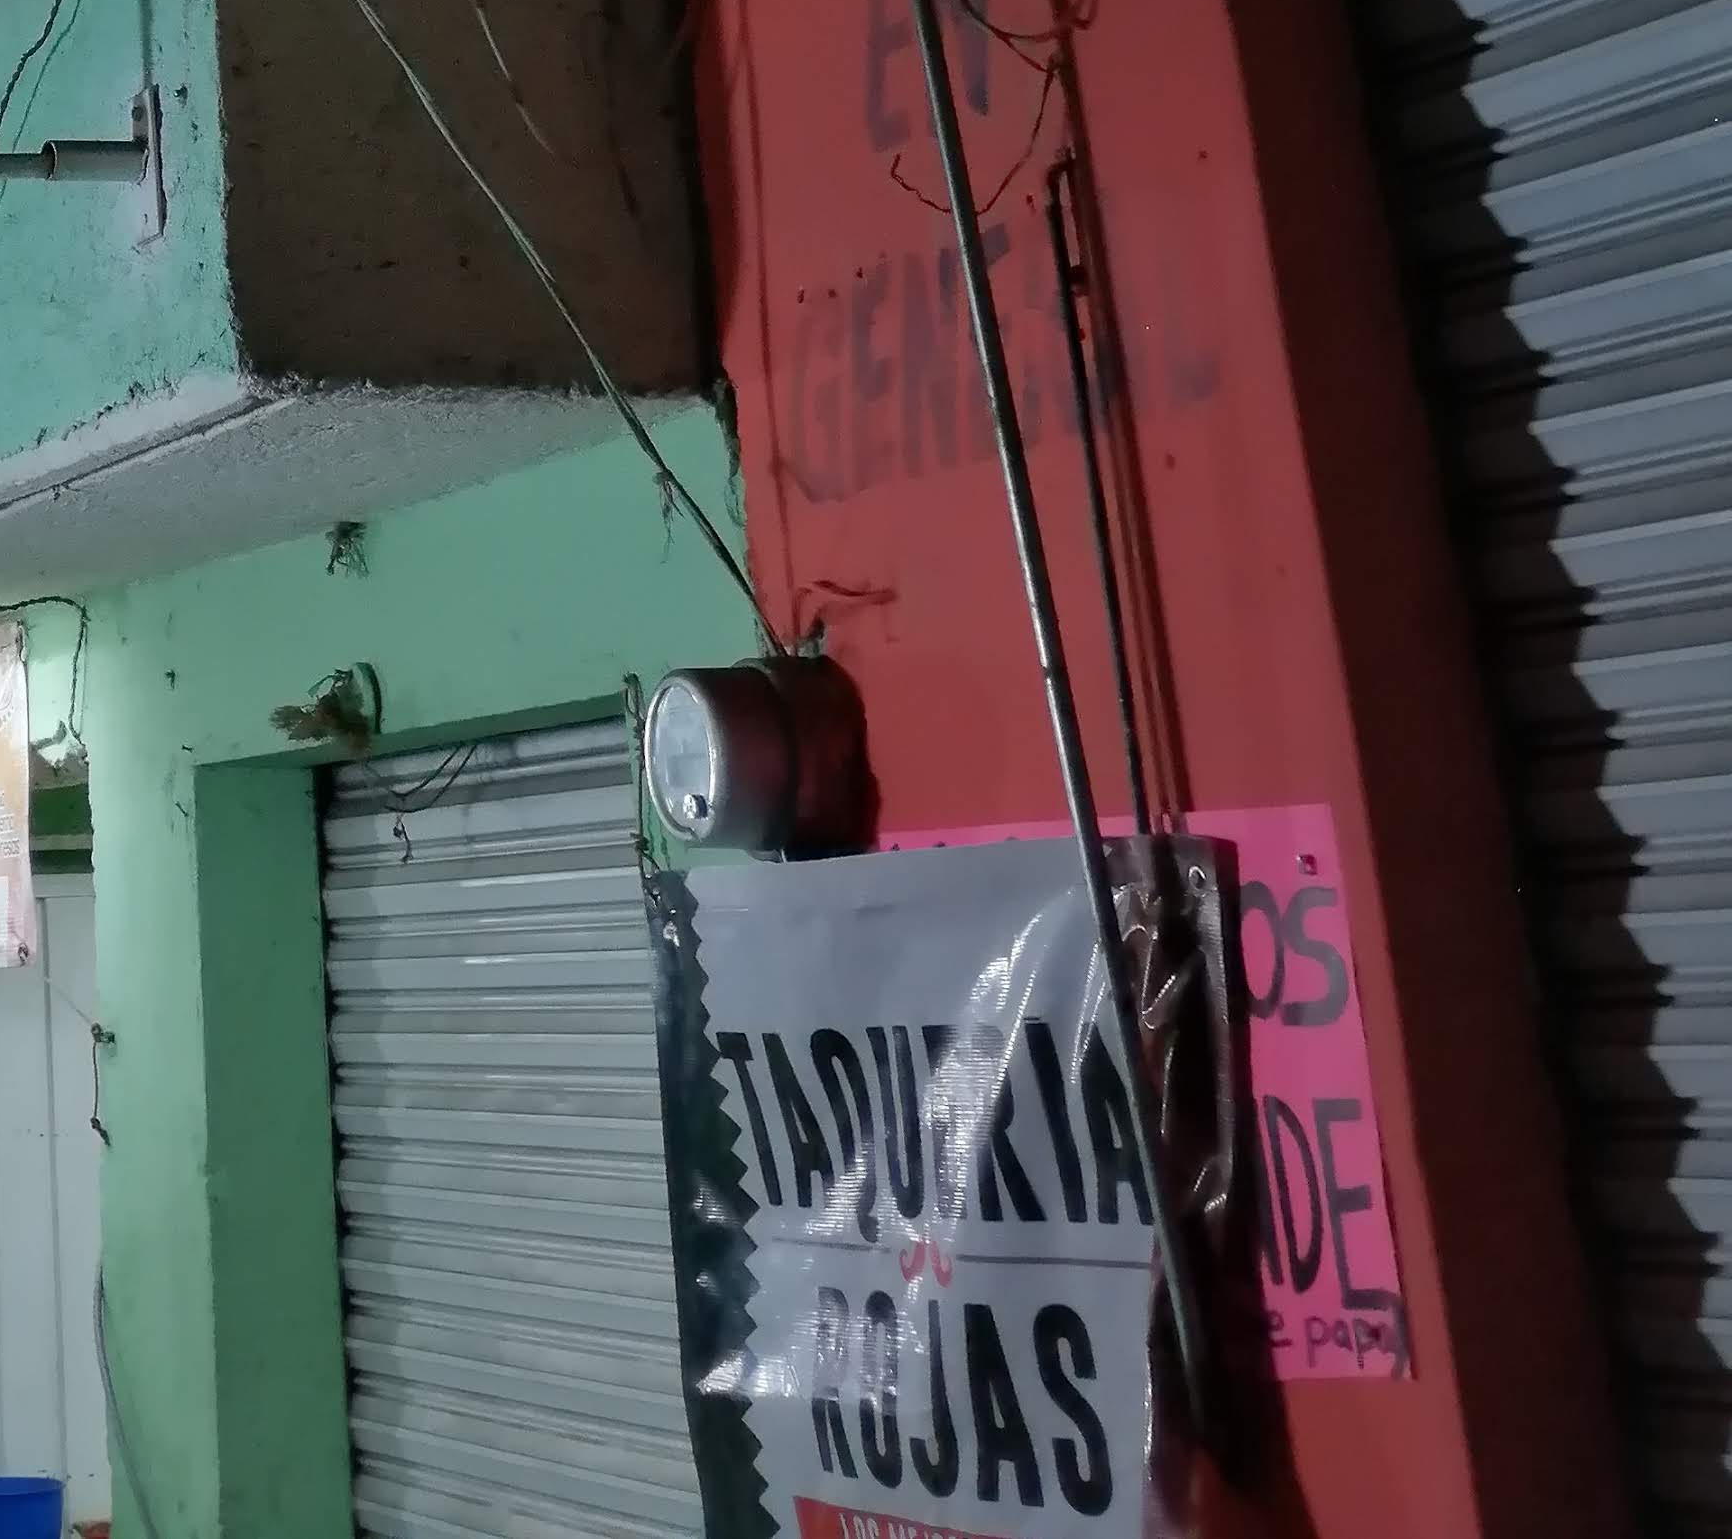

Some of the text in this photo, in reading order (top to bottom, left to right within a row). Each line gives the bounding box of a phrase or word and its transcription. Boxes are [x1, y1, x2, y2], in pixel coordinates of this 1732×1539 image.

[1239, 880, 1350, 1027] OS
[716, 1019, 1155, 1243] TAQUERIA
[1256, 1094, 1398, 1311] DE
[812, 1287, 1114, 1517] ROJAS
